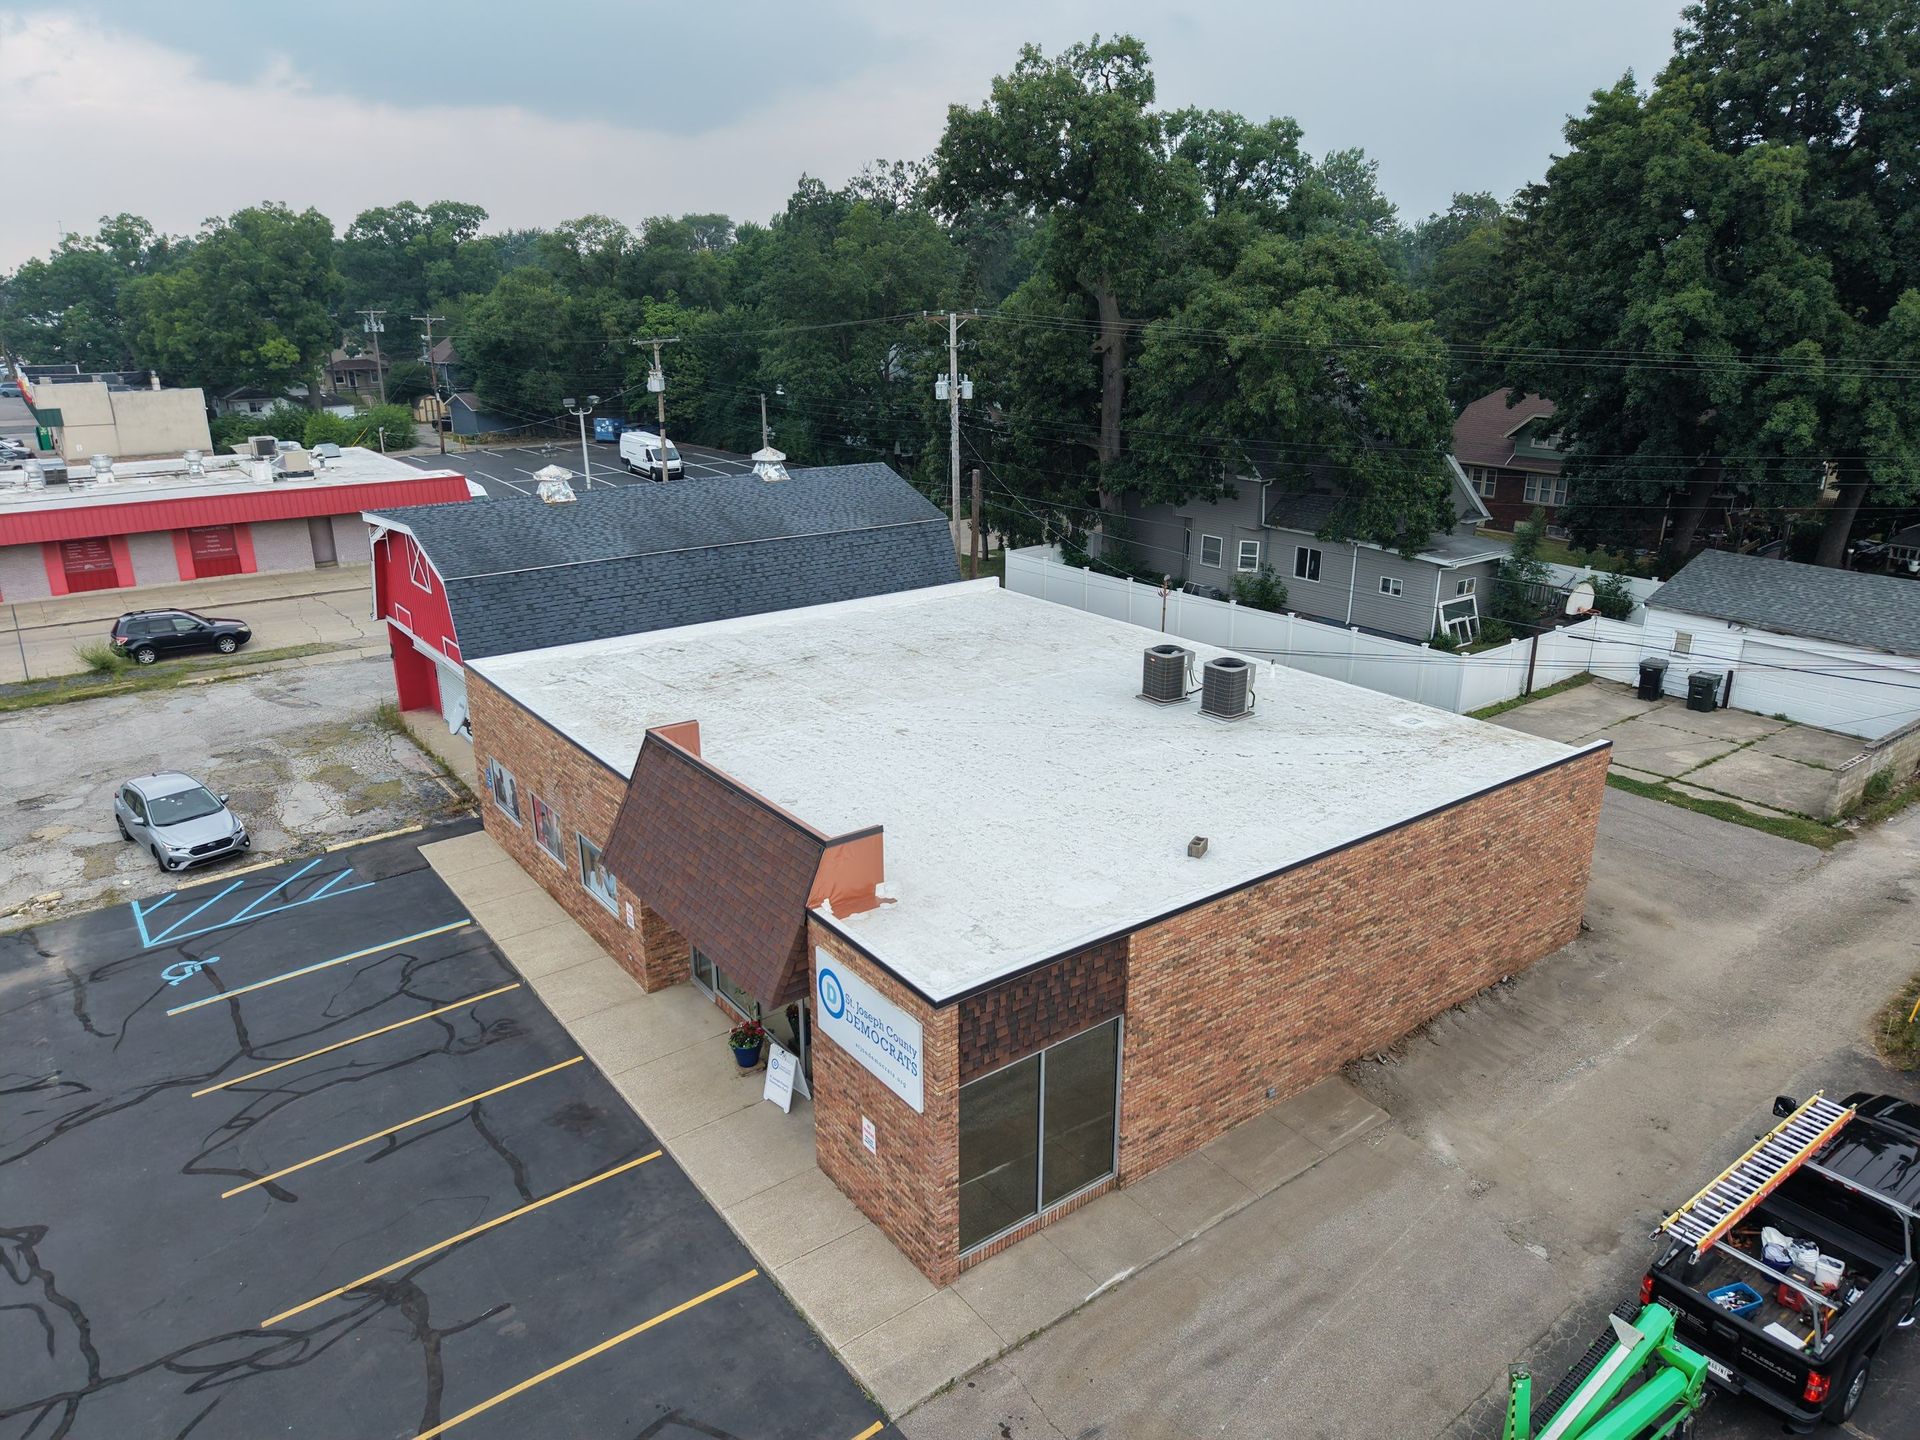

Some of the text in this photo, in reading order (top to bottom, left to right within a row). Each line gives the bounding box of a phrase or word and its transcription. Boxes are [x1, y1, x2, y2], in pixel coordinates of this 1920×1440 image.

[845, 993, 918, 1058] St. Joseph County
[845, 1008, 918, 1077] DEMOCRATS
